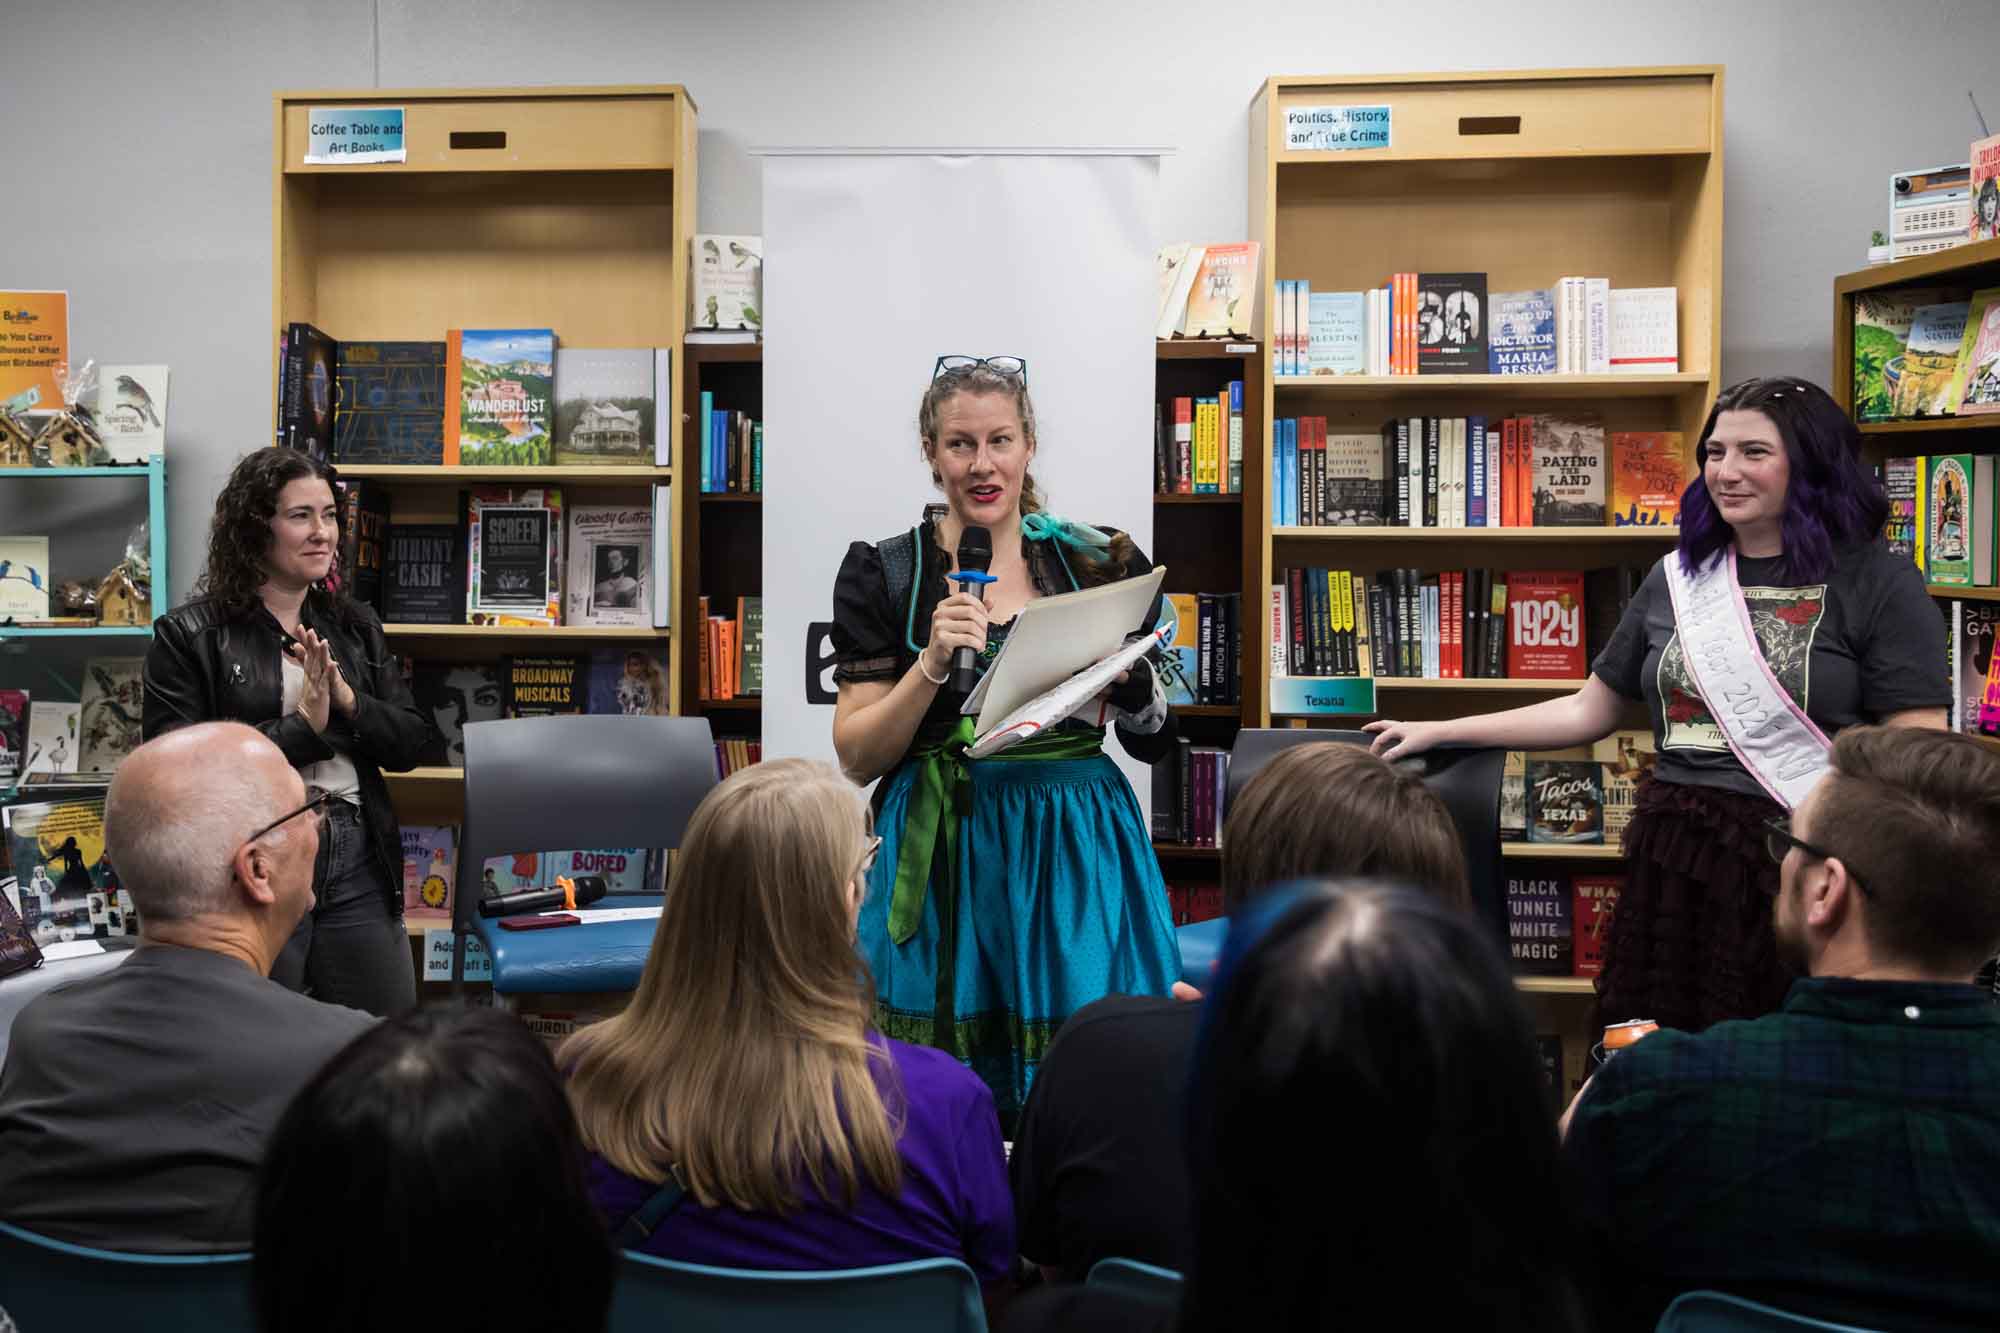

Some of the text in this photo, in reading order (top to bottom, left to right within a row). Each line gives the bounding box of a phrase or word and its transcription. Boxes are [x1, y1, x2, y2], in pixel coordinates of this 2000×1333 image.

[311, 123, 403, 136] Coffee Table and
[1350, 129, 1387, 142] Crime
[328, 142, 385, 154] Art Books
[1308, 334, 1360, 343] ALESTINE
[1493, 333, 1554, 347] DICTATOR
[1497, 351, 1549, 365] MARIA
[1501, 364, 1546, 376] RESSA
[467, 399, 545, 414] WANDERLUST
[1473, 425, 1483, 497] FREEDOM SEASON
[1542, 455, 1598, 468] PAYING
[1549, 475, 1592, 486] LAND
[488, 516, 540, 545] SCREEN
[387, 537, 454, 562] JOHNNY
[399, 562, 442, 587] CASH
[1399, 597, 1409, 641] SURVIVOR
[1411, 597, 1421, 641] SURVIVOR
[1510, 599, 1580, 648] 1929
[1216, 623, 1225, 684] STAR BOUND
[511, 667, 575, 683] BROADWAY
[514, 687, 571, 703] MUSICALS
[1304, 694, 1346, 708] Texana
[1534, 776, 1594, 803] Tacos
[1541, 808, 1588, 822] TEXAS
[571, 851, 628, 873] BORED
[1508, 879, 1559, 896] BLACK
[1508, 922, 1559, 938] WHITE
[1511, 942, 1559, 960] MAGIC
[428, 959, 449, 971] and
